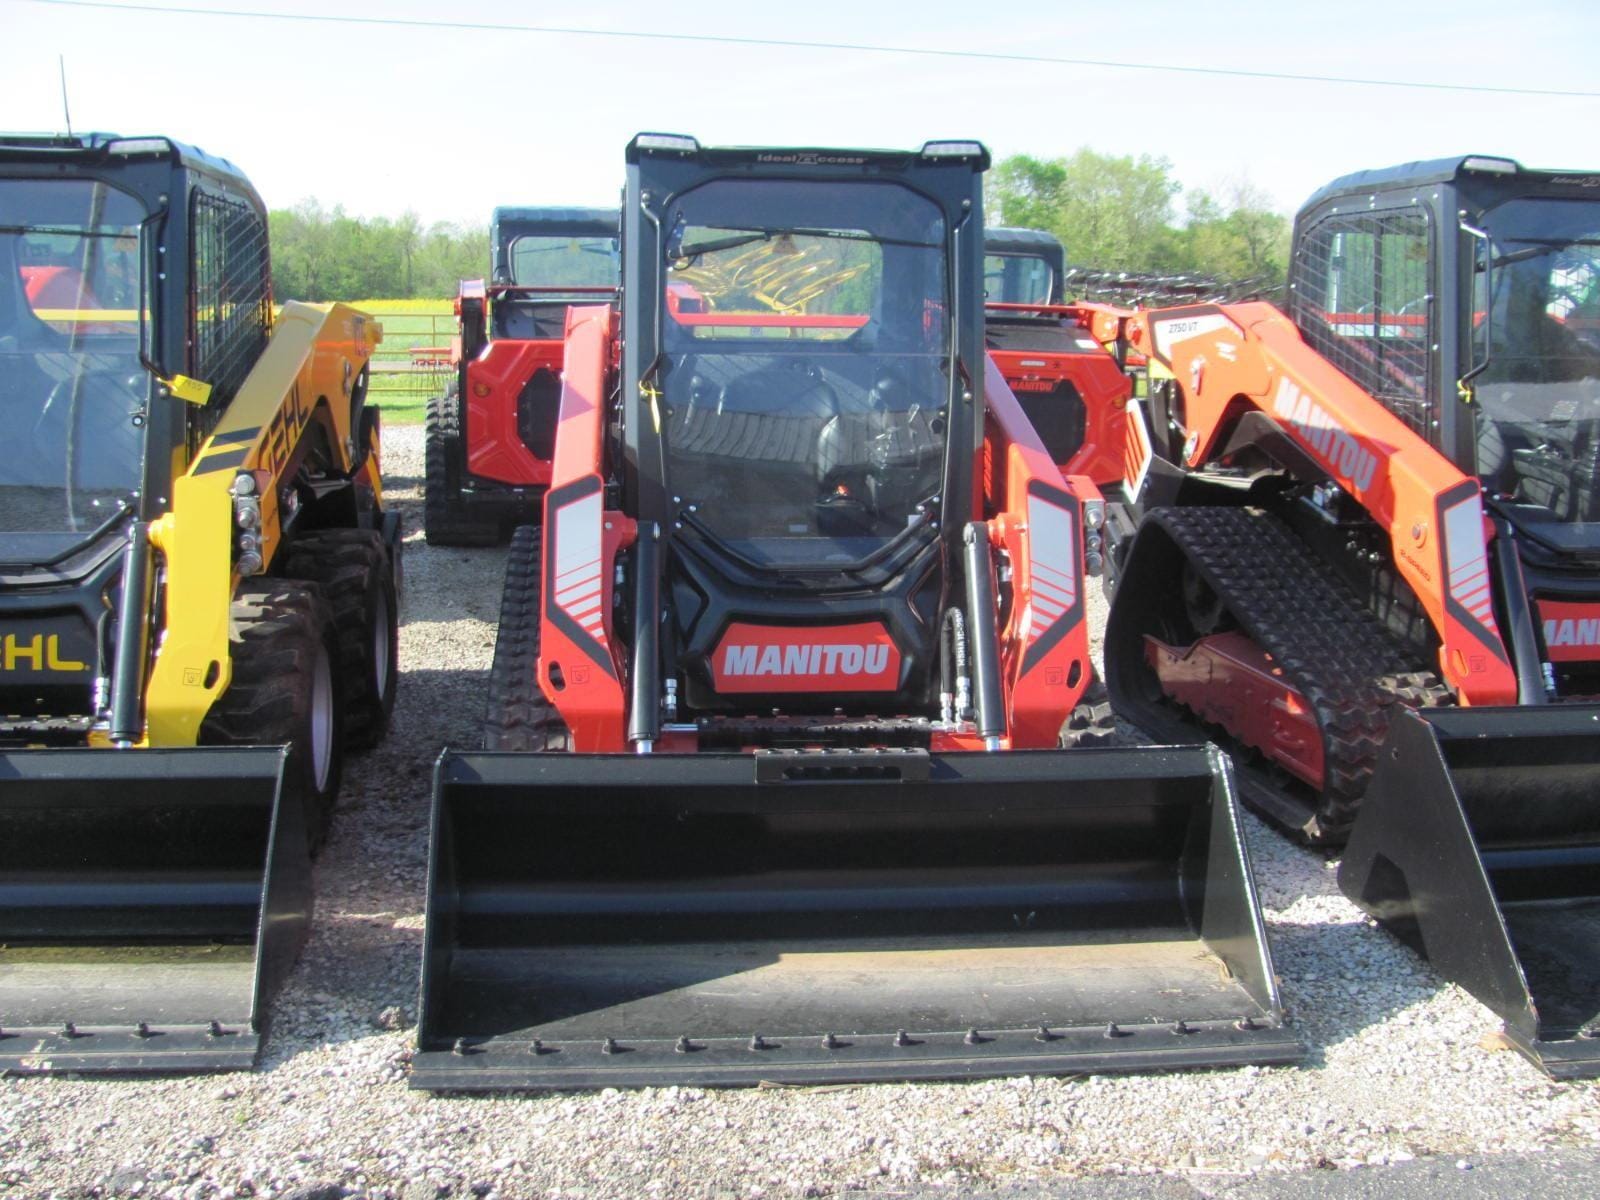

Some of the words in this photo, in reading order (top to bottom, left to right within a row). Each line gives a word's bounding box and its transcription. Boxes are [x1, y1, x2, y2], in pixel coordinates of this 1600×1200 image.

[1273, 375, 1378, 493] MANITOU
[0, 633, 84, 671] HL
[723, 644, 889, 675] MANITOU
